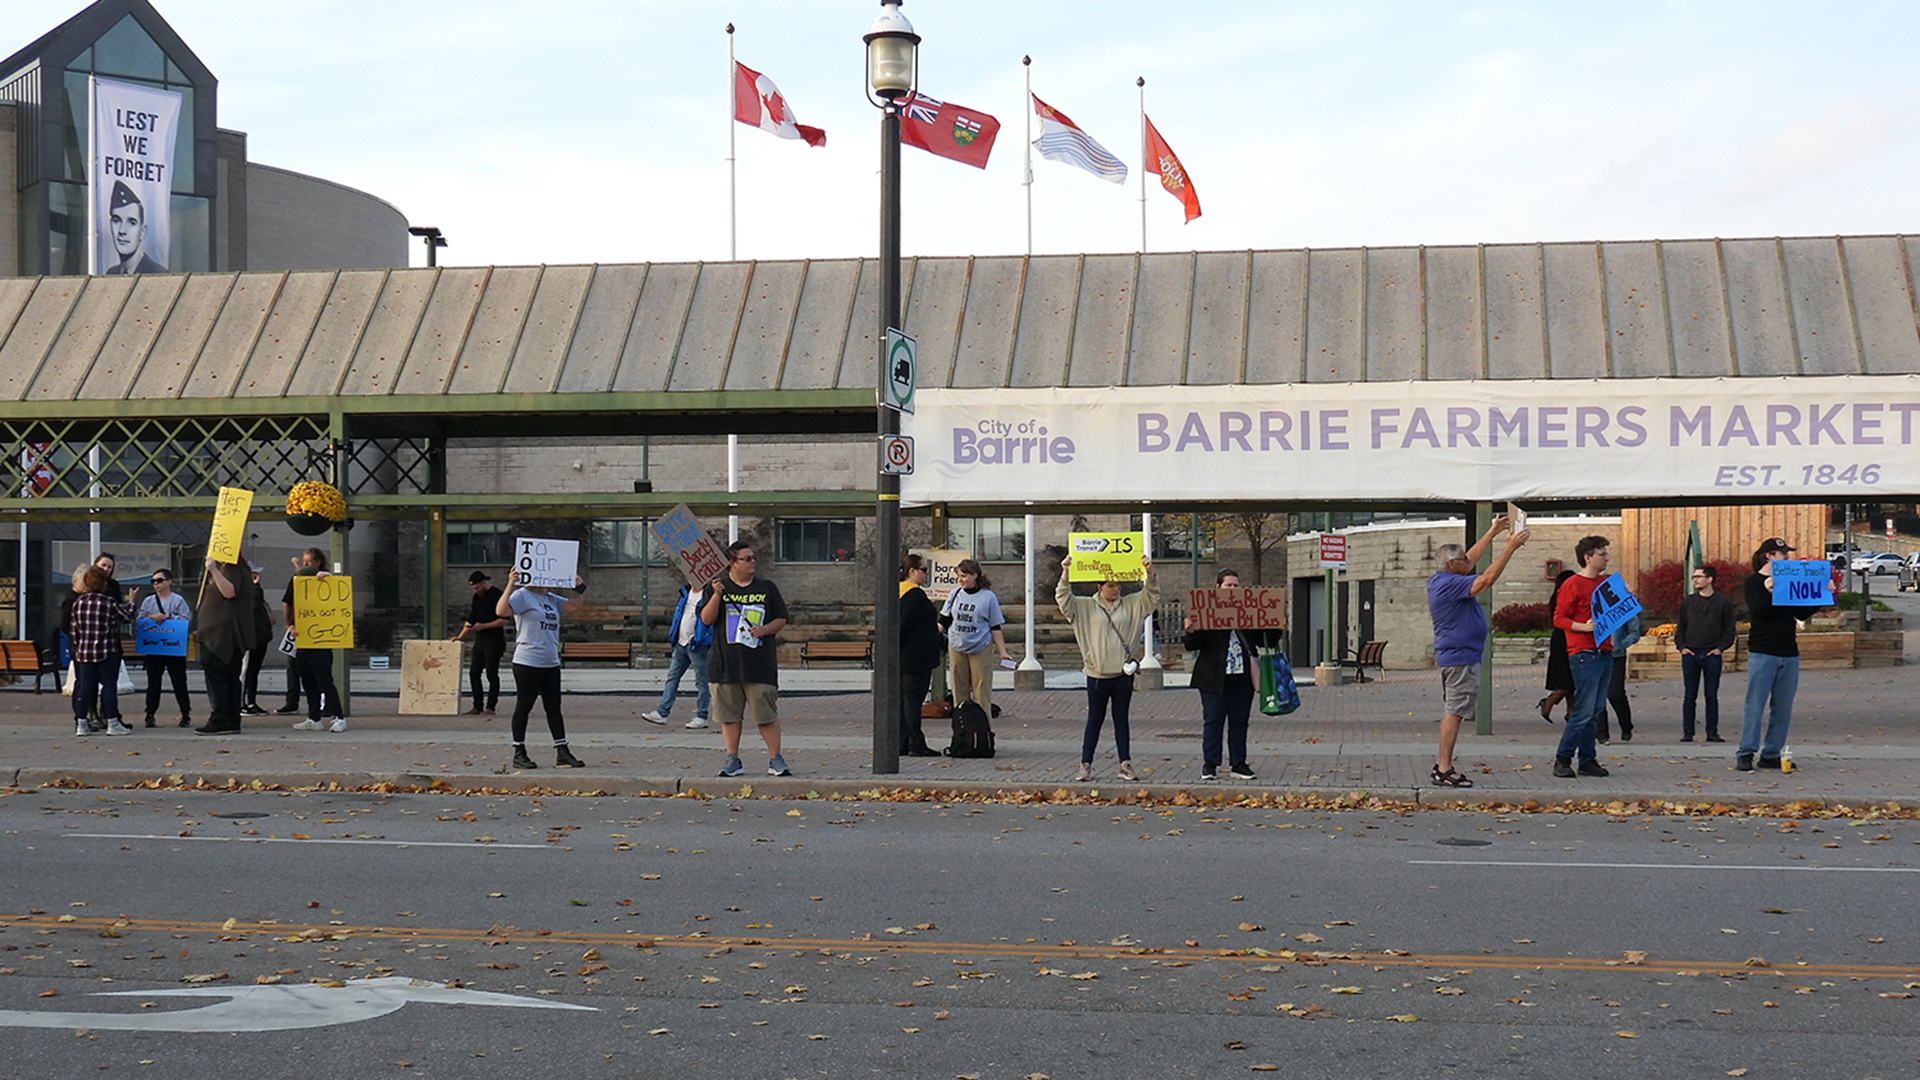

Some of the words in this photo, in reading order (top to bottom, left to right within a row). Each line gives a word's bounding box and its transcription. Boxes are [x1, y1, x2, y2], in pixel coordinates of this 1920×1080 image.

[117, 109, 158, 132] LEST
[123, 134, 148, 155] WE
[105, 156, 165, 182] FORGET
[978, 419, 1009, 437] City
[1018, 418, 1036, 434] of
[1137, 409, 1350, 453] BARRIE
[1371, 405, 1647, 449] FARMERS
[1669, 402, 1920, 447] MARKET
[953, 427, 1075, 464] Barrie
[1714, 465, 1786, 486] EST.
[1801, 464, 1881, 486] 1846
[688, 552, 725, 584] Transit
[1771, 562, 1800, 577] Better
[300, 578, 351, 601] TOD
[749, 593, 767, 603] BOY
[1189, 589, 1205, 610] 10
[1208, 589, 1243, 609] Minutes
[1259, 589, 1280, 609] Car
[1789, 581, 1822, 600] NOW
[298, 609, 316, 618] HAS
[319, 608, 336, 617] GOT
[1206, 608, 1234, 629] Hour
[1257, 608, 1280, 627] Bus
[1605, 595, 1638, 624] TRANSIT
